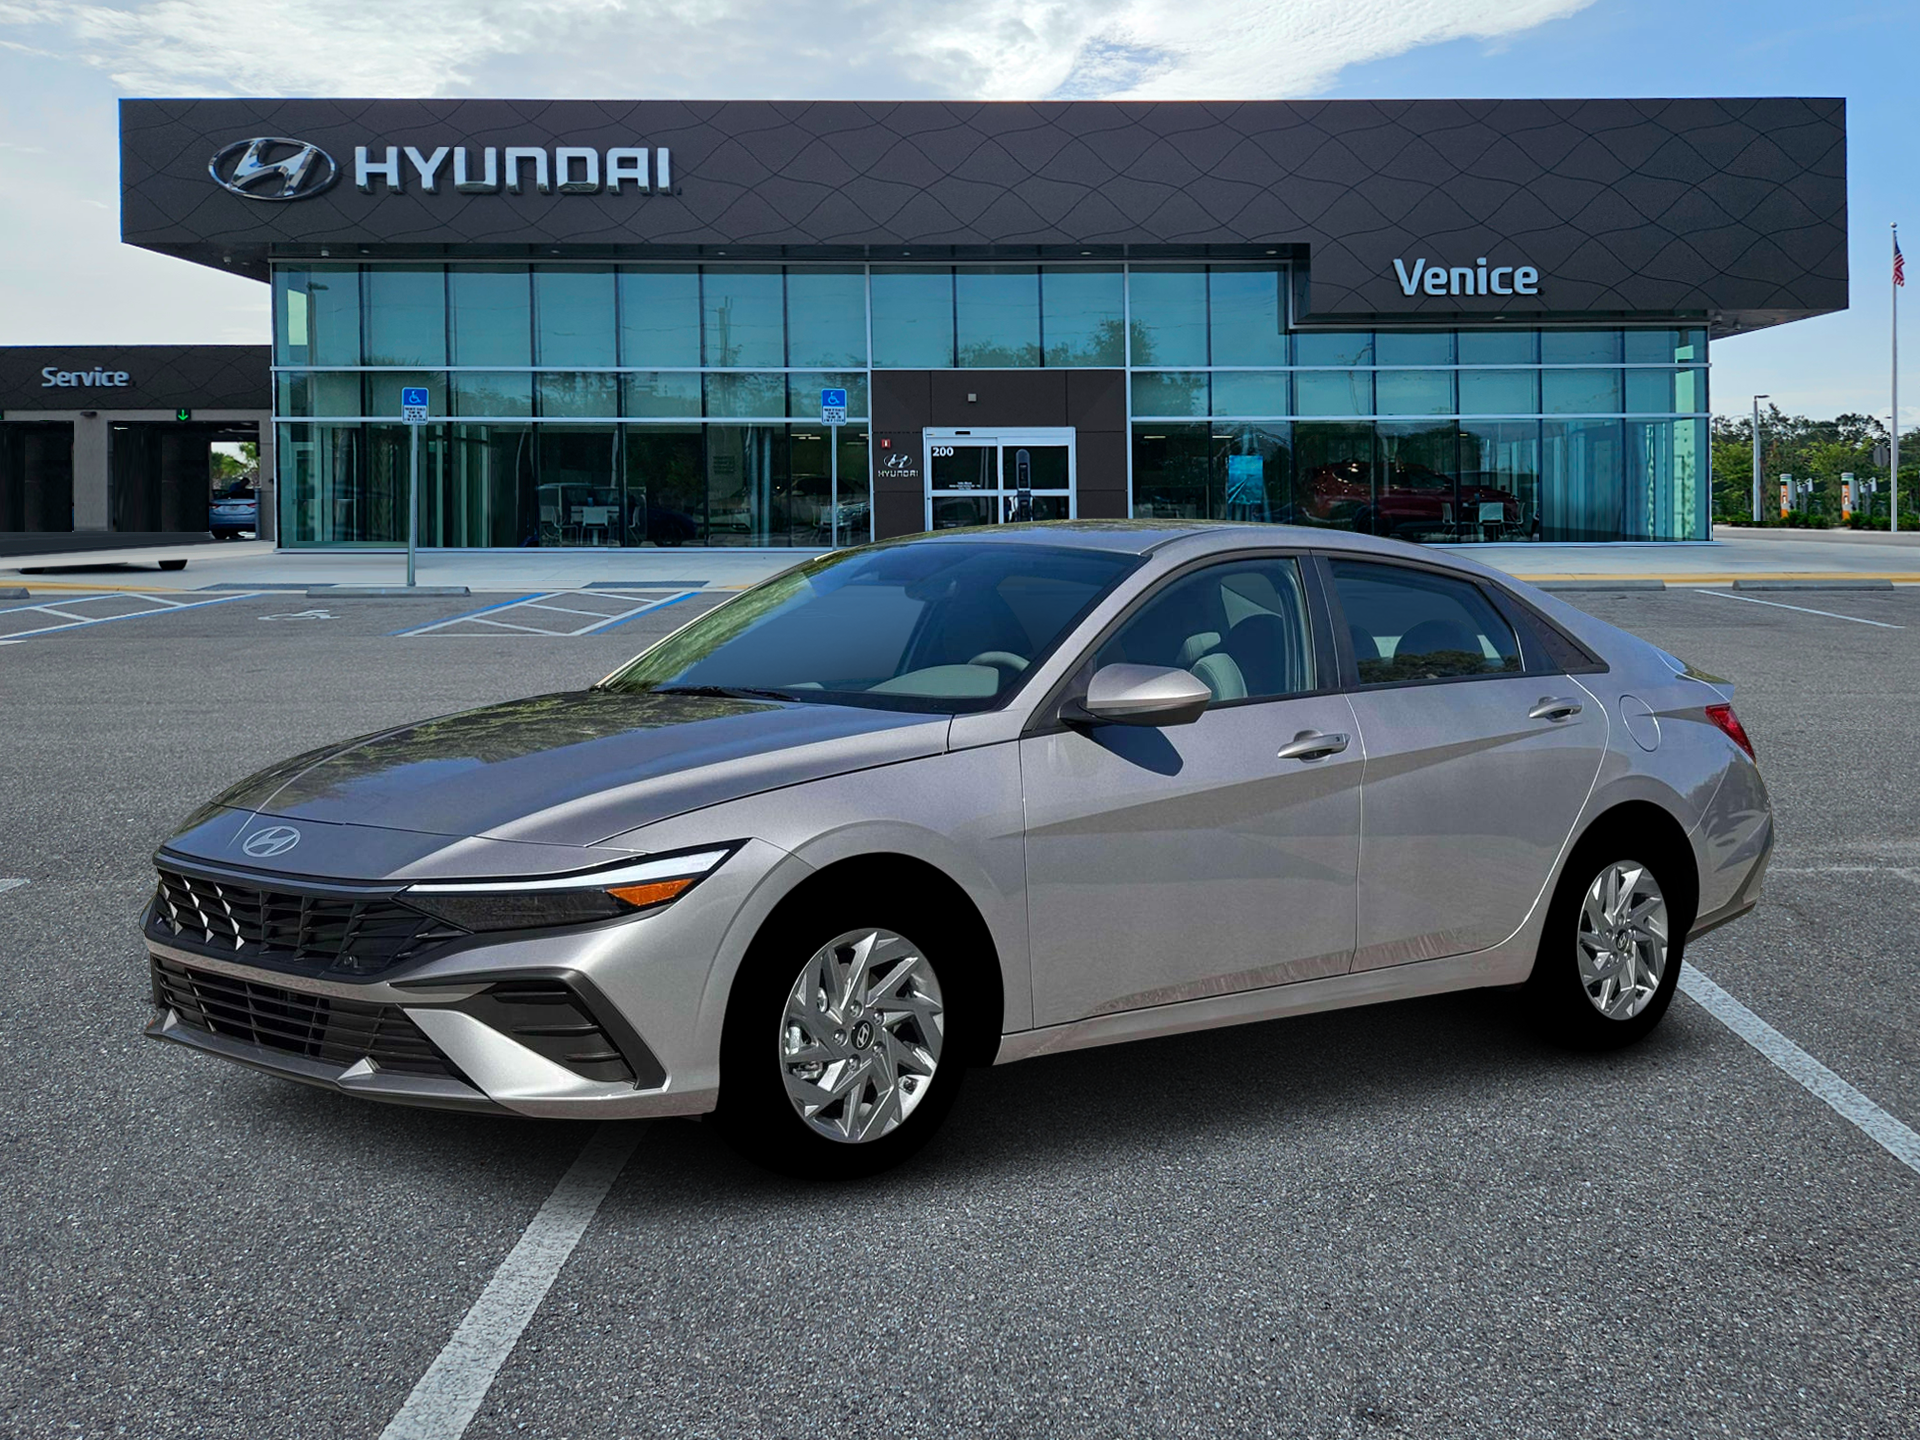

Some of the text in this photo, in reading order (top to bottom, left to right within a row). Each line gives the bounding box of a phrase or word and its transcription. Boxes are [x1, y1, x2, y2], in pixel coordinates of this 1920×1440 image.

[354, 146, 670, 194] HYUNDAI
[1393, 257, 1539, 295] Venice
[41, 366, 130, 387] Service
[932, 447, 954, 457] 200
